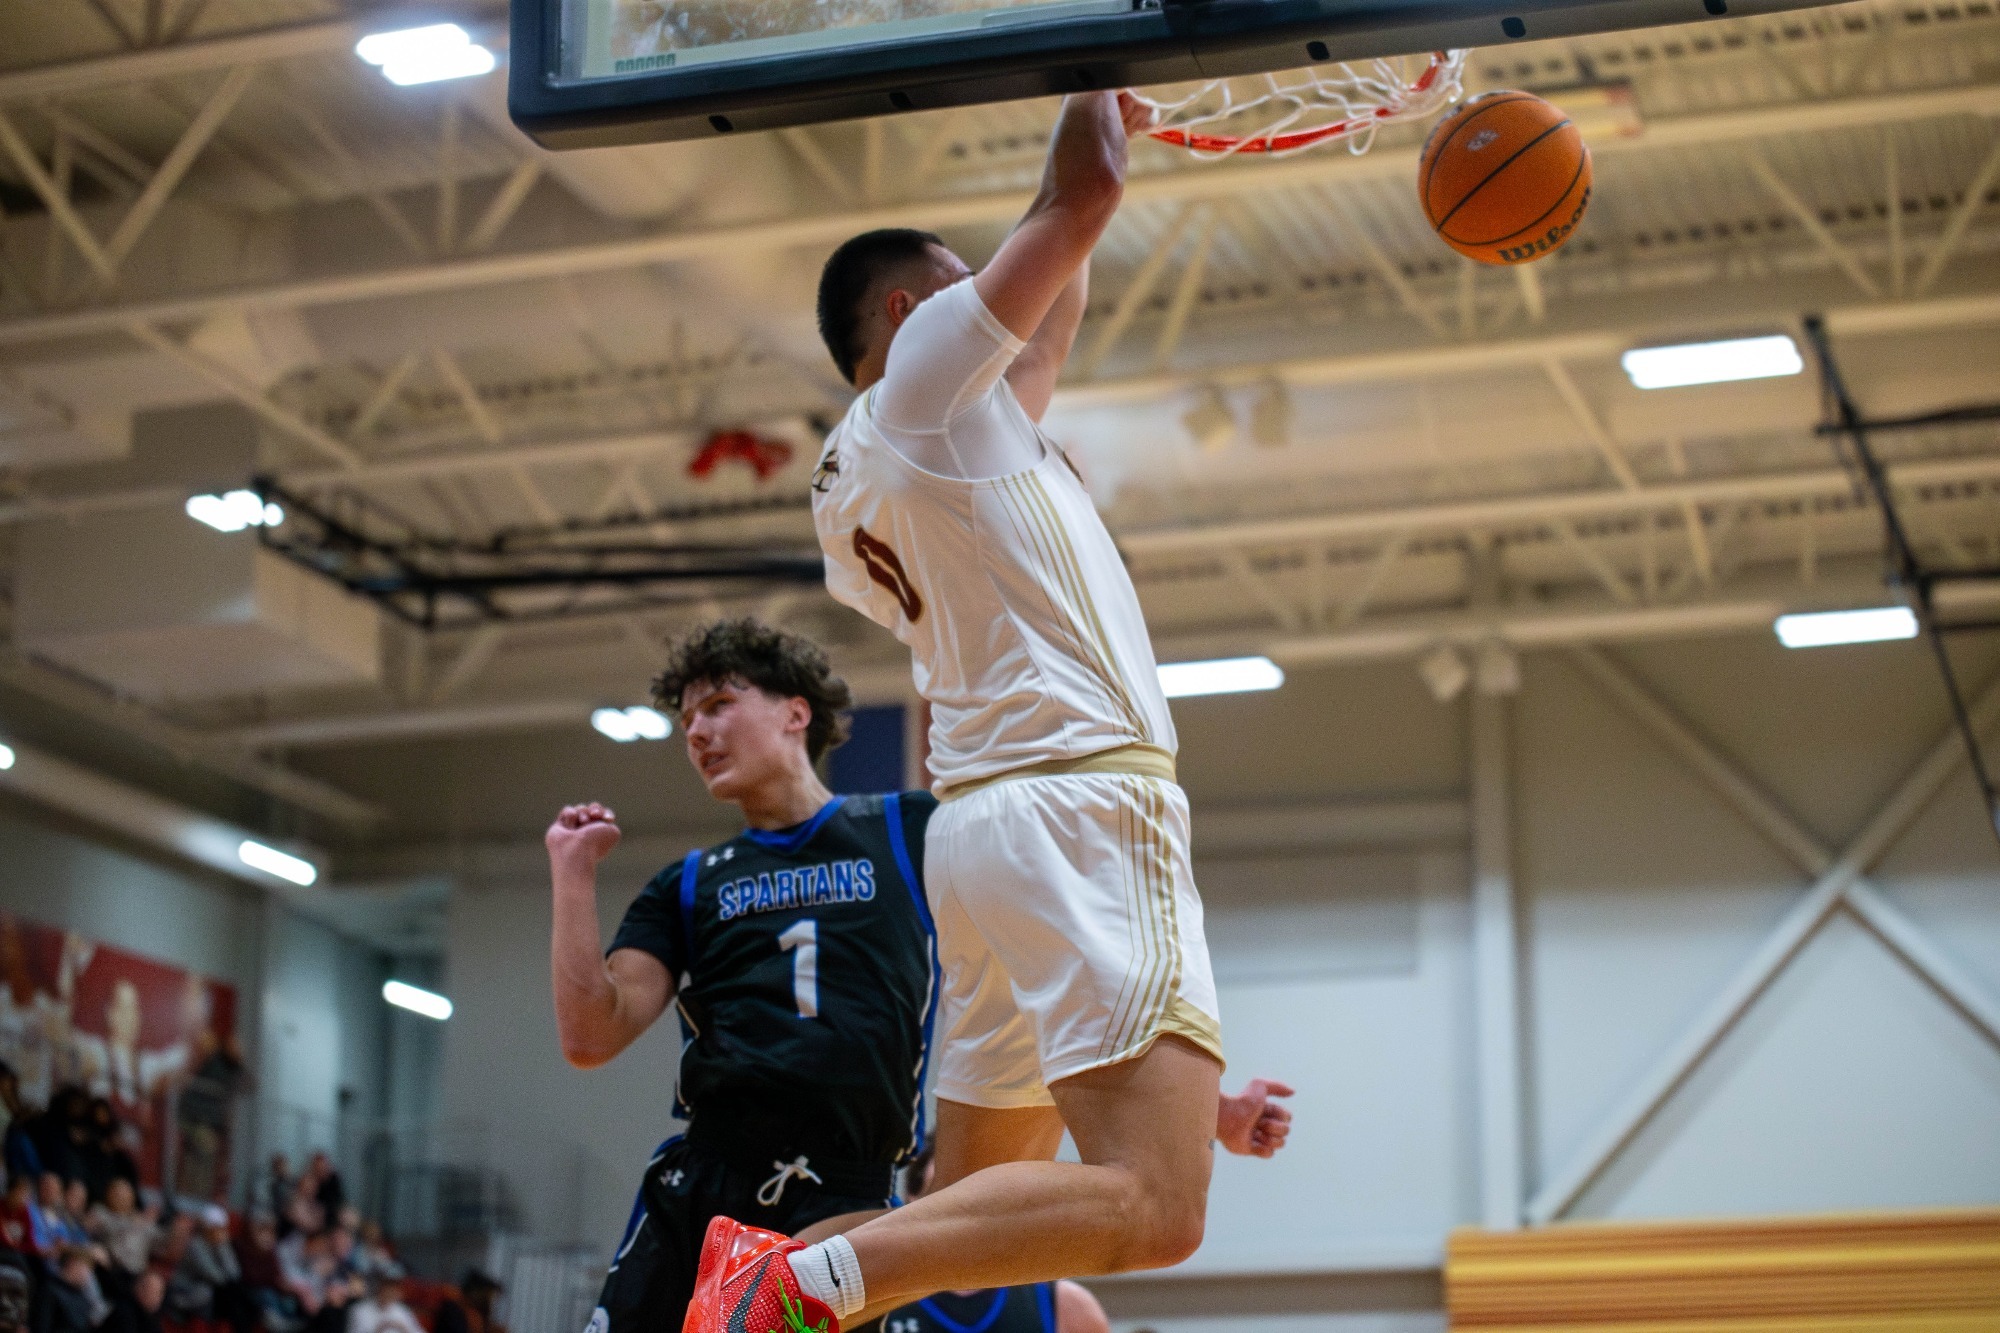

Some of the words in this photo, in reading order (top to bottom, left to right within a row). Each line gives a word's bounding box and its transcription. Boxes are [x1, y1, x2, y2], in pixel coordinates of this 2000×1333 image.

[852, 525, 924, 625] 0
[718, 858, 877, 920] SPARTANS
[777, 918, 818, 1018] 1
